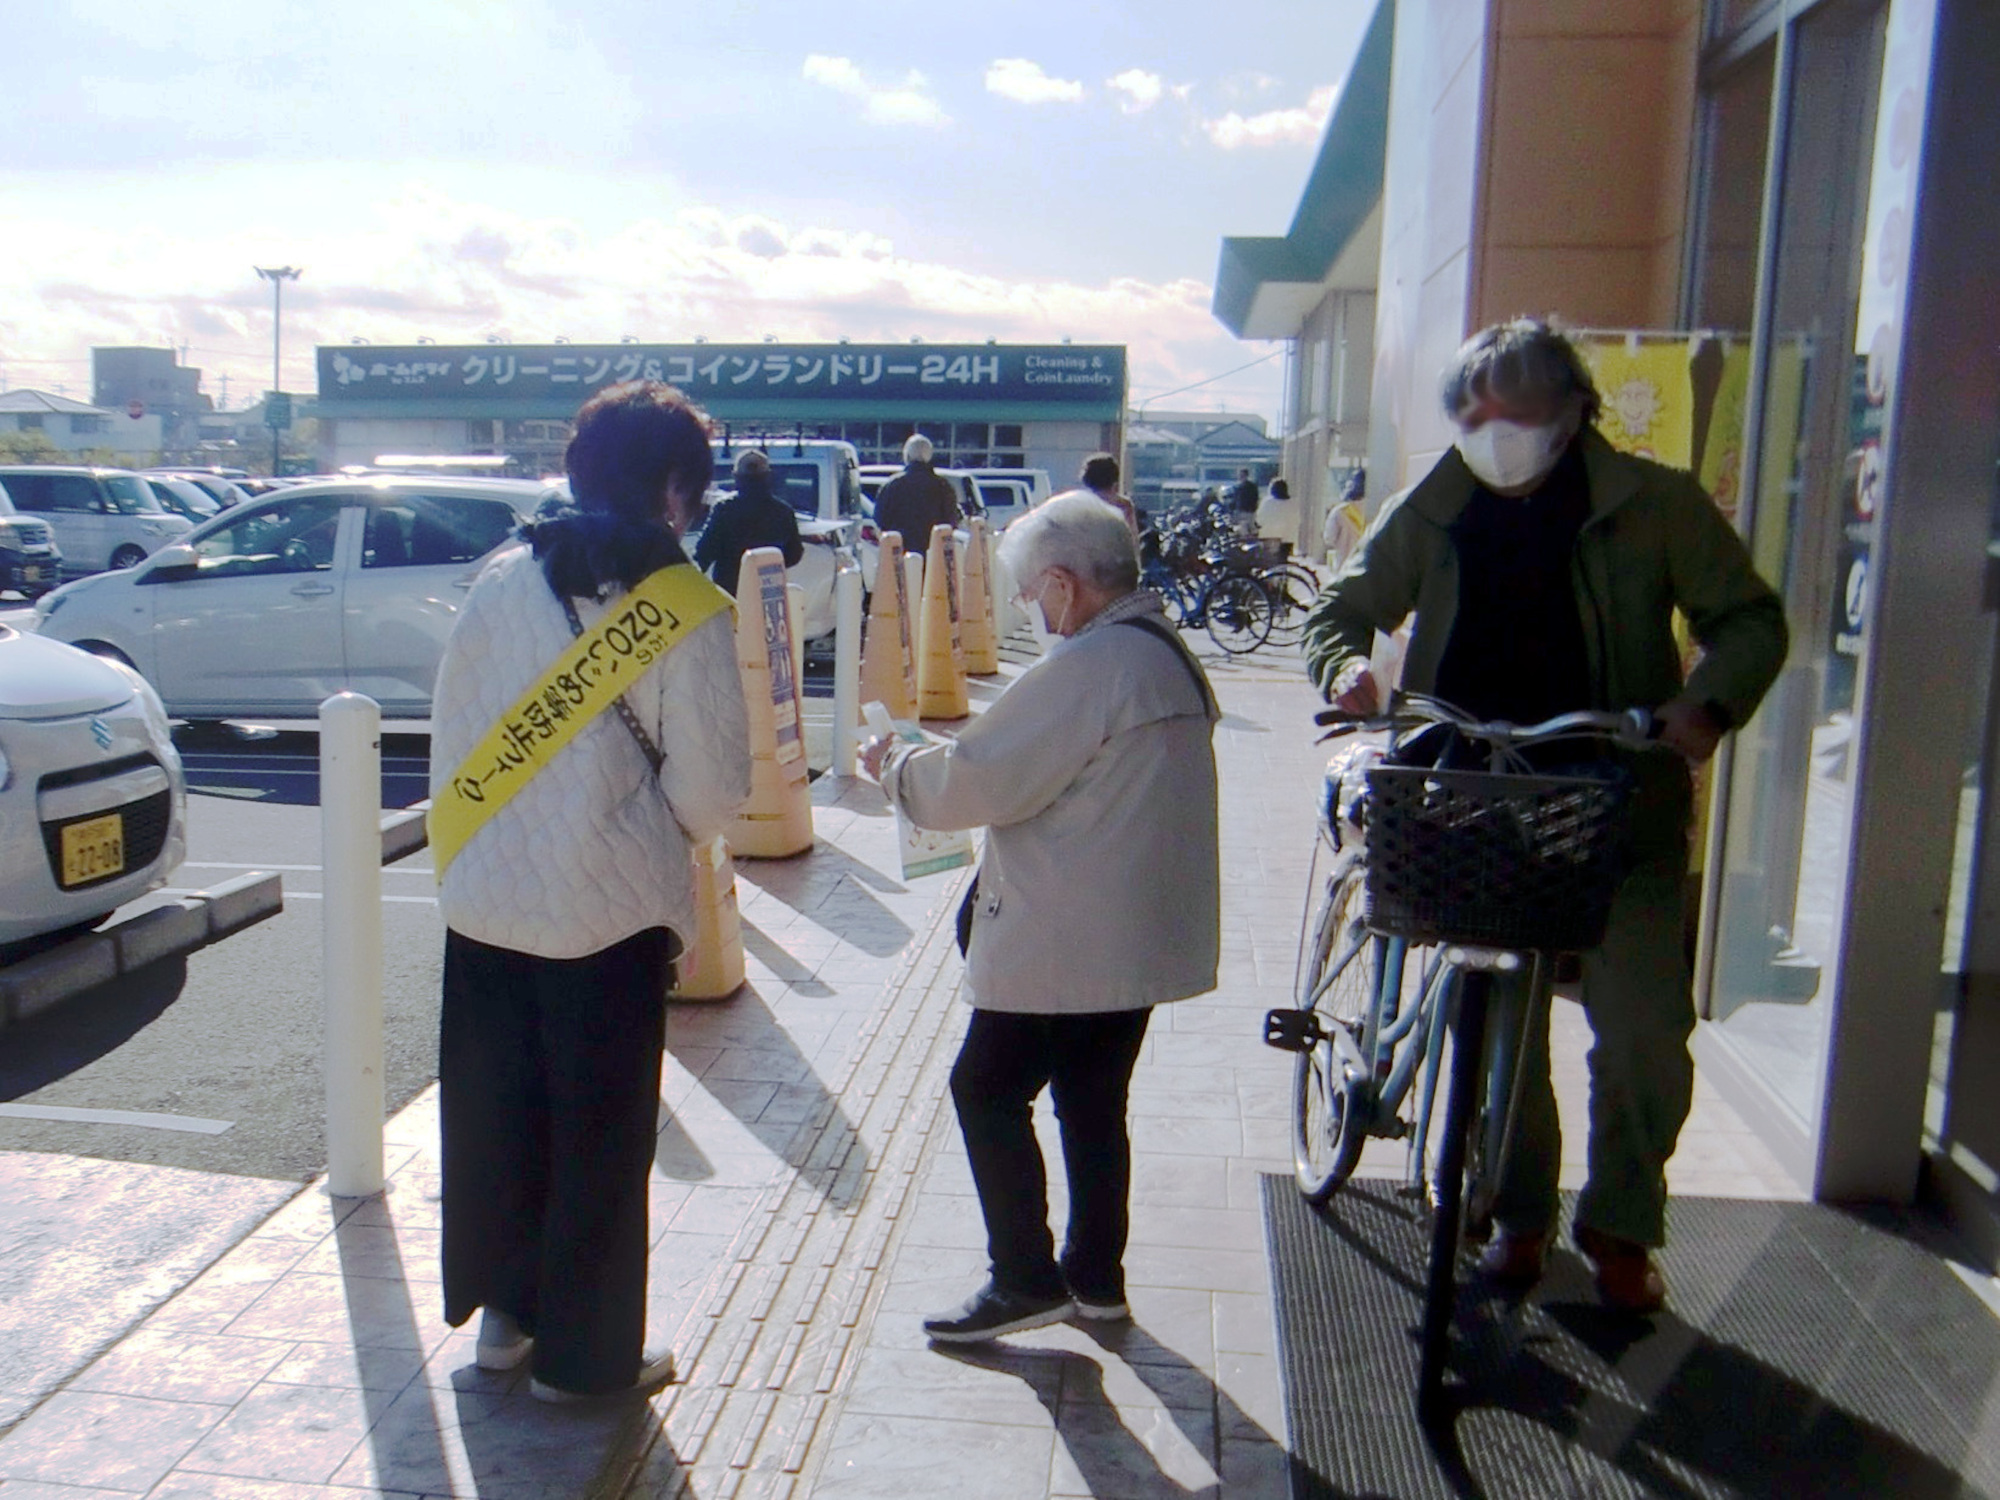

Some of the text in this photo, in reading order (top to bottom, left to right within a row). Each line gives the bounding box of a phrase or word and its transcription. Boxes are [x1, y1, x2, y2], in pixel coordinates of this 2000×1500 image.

[1025, 355, 1102, 370] Cleaning &
[1024, 370, 1113, 386] CoinLaundry
